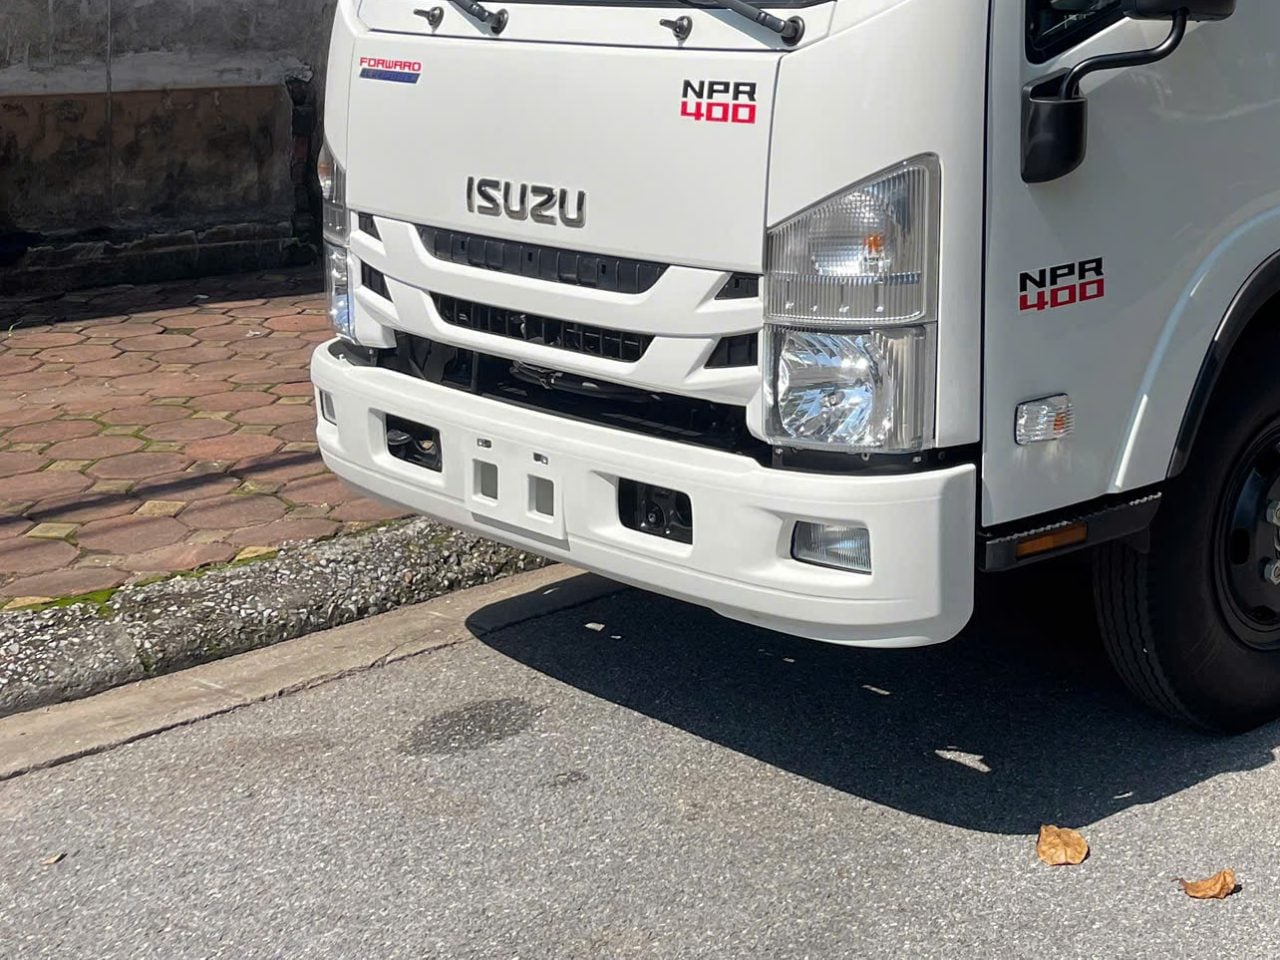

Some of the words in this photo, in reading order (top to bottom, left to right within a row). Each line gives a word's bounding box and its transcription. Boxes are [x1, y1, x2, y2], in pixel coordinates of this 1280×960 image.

[682, 79, 757, 102] NPR
[680, 100, 757, 124] 400
[466, 176, 588, 229] ISUZU
[1019, 257, 1104, 292] NPR
[1019, 278, 1104, 311] 400
